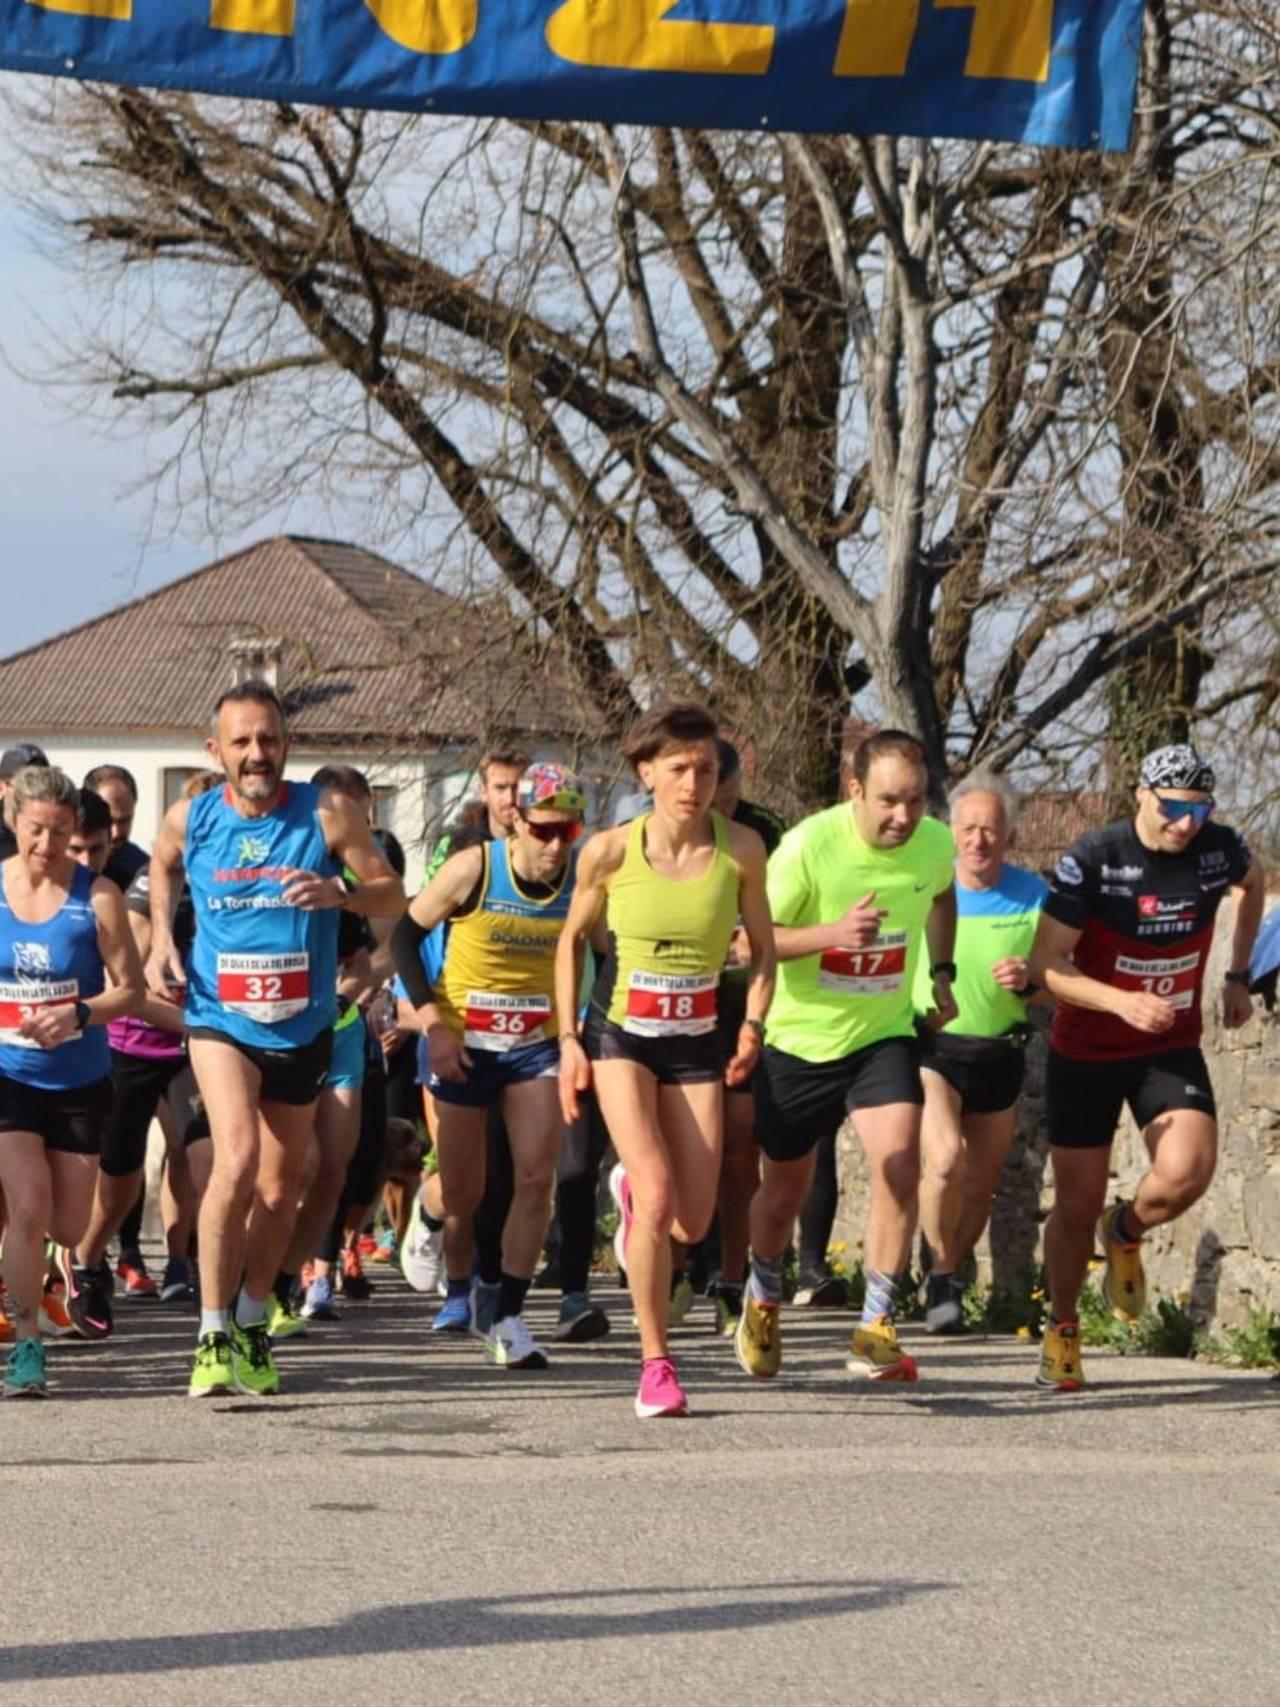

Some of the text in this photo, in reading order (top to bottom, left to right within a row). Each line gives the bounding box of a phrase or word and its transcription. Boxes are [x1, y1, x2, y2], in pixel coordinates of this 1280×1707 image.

[850, 952, 884, 975] 17
[245, 976, 282, 1000] 32
[1141, 977, 1175, 995] 10
[657, 995, 694, 1018] 18
[490, 1012, 526, 1033] 36
